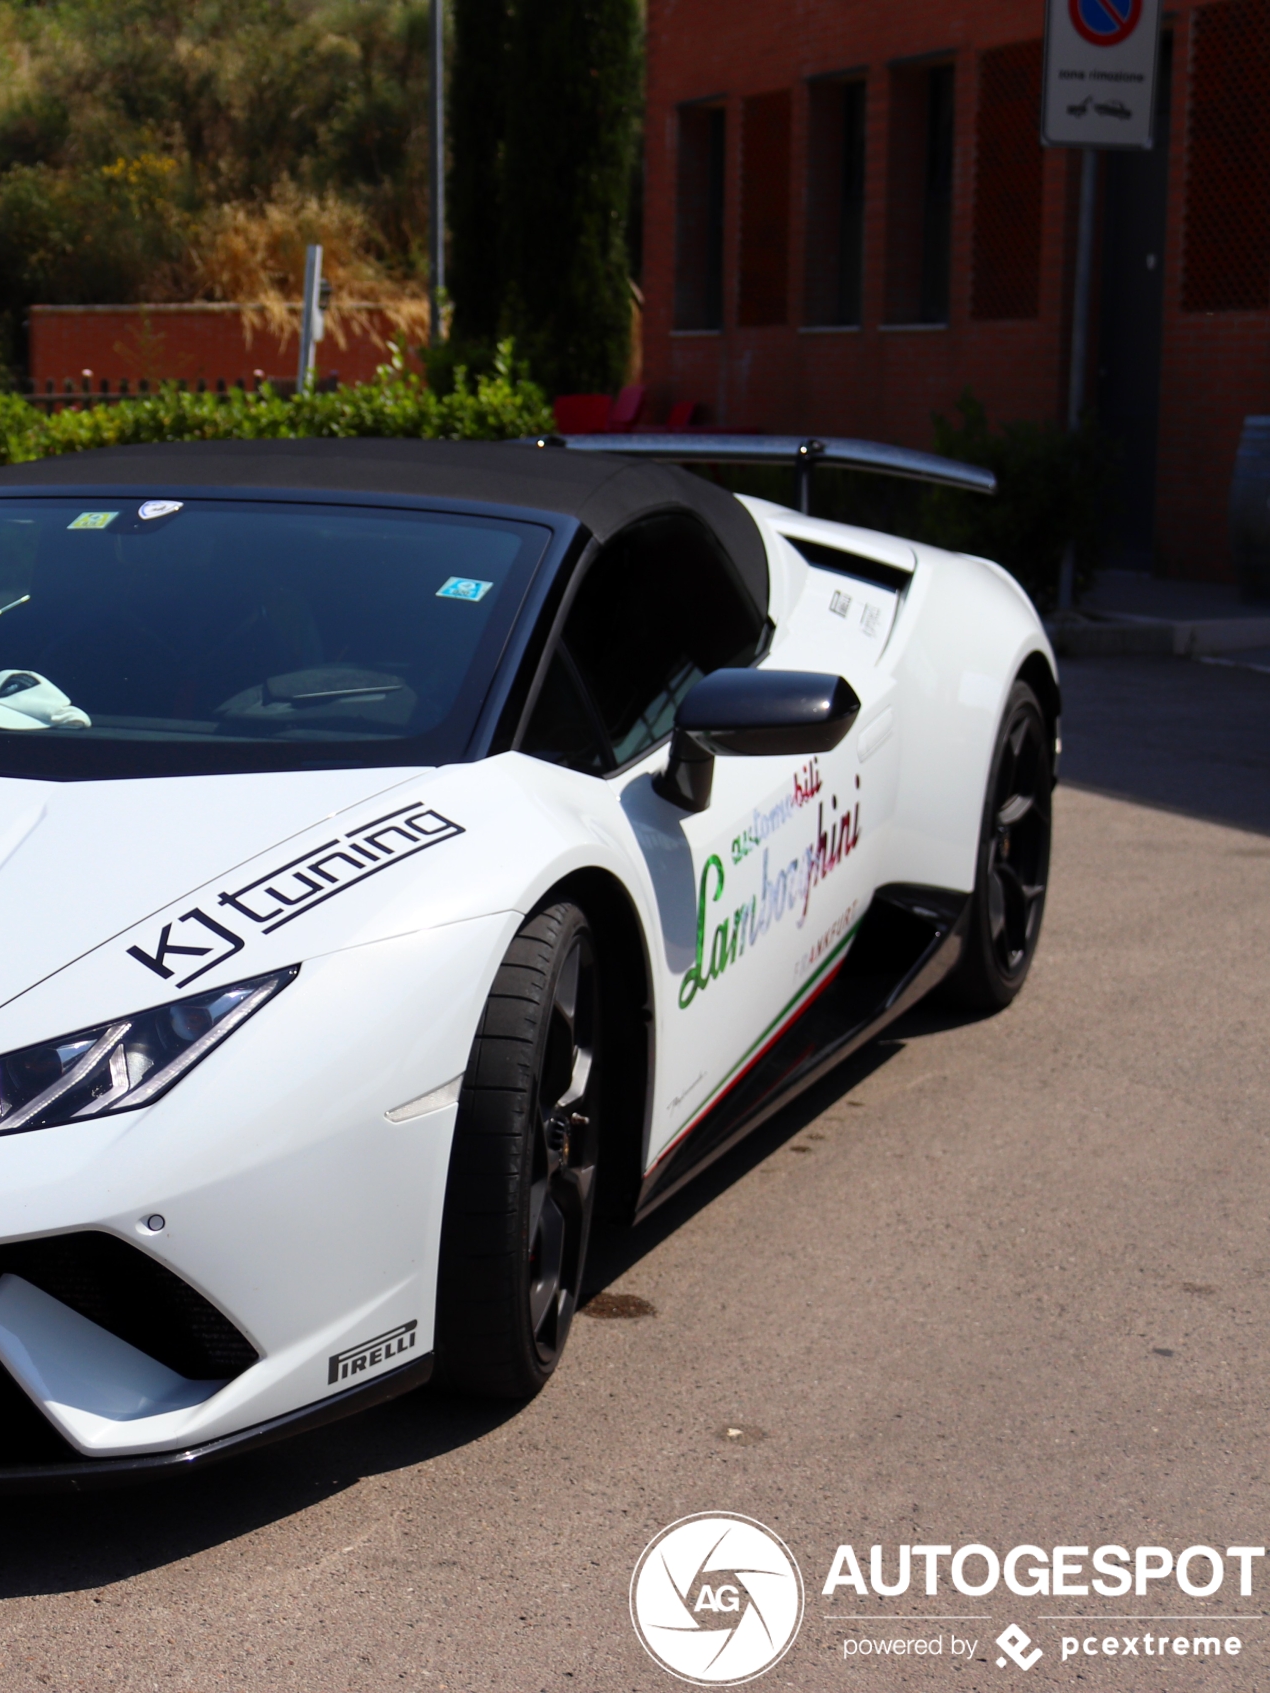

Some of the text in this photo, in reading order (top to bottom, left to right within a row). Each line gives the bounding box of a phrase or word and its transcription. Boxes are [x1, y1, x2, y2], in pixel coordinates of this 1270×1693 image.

[126, 801, 466, 989] KJ tuning
[678, 774, 861, 1009] Lamborghini
[328, 1319, 418, 1386] PIRELLI
